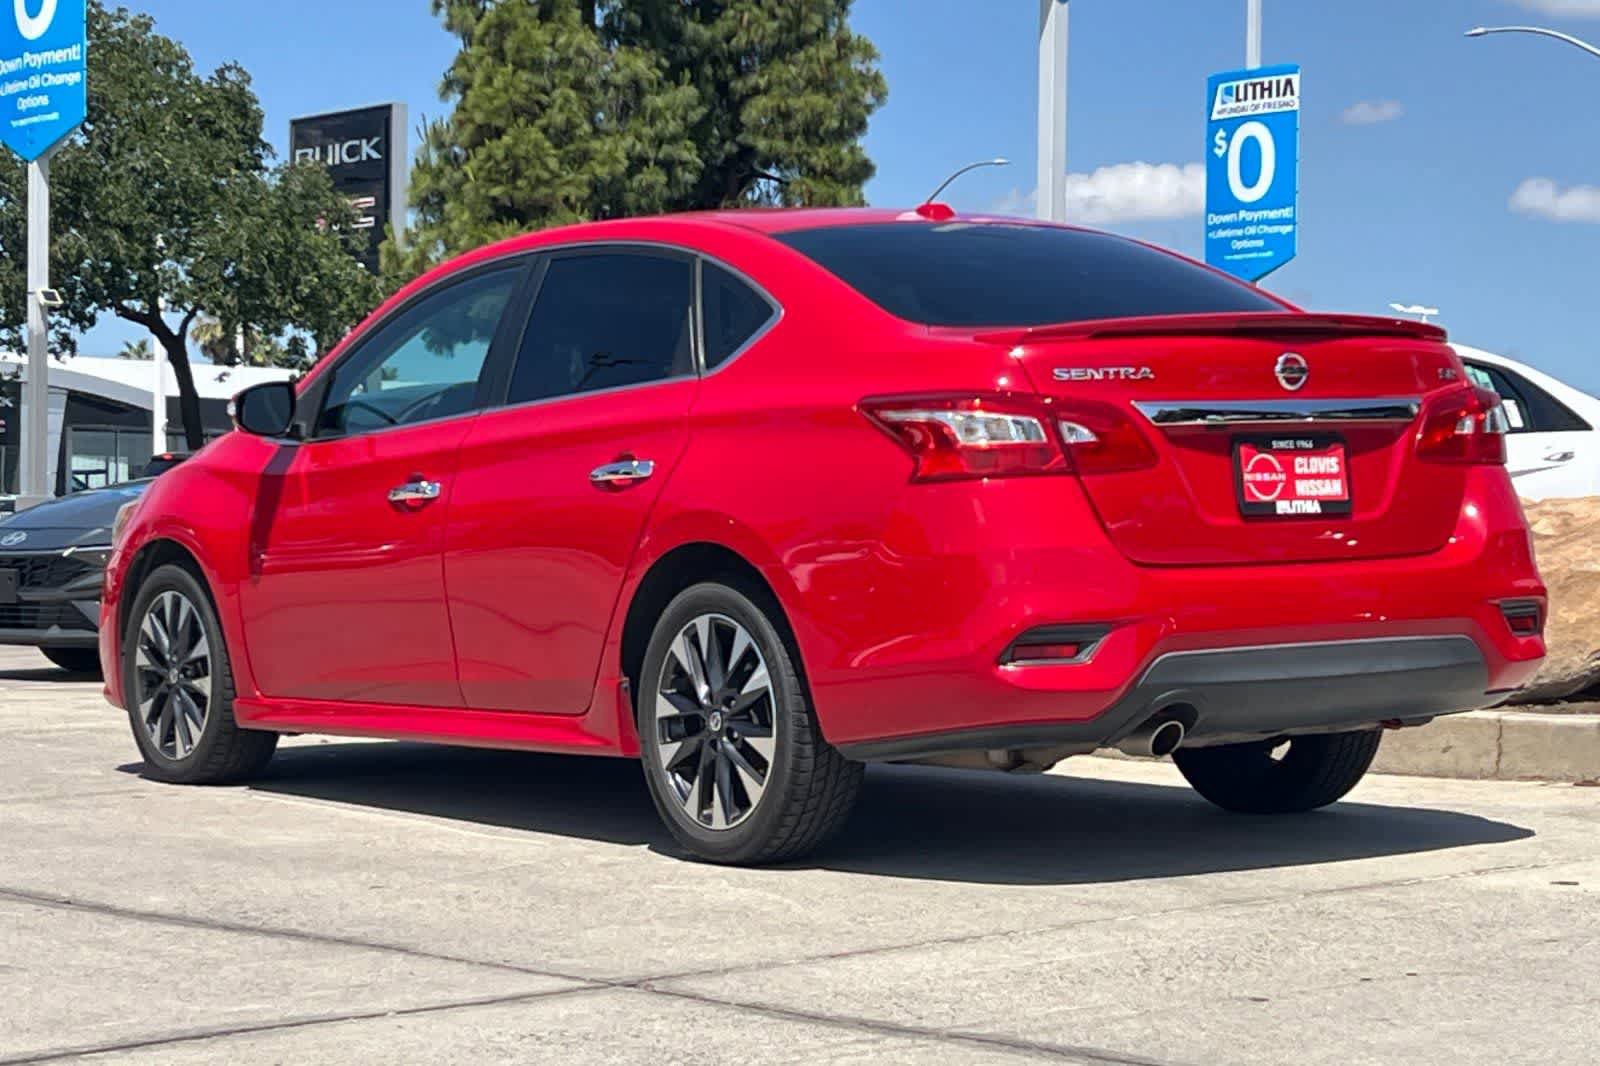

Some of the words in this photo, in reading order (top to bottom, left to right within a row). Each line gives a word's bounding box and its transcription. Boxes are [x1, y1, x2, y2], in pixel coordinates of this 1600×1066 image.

[23, 43, 81, 69] Payment!
[28, 73, 40, 89] Oil
[41, 71, 81, 87] Change
[1235, 78, 1295, 103] LITHIA
[17, 94, 49, 112] Options
[1207, 212, 1238, 226] Down
[1257, 224, 1294, 235] Change
[1231, 239, 1264, 250] Options
[1053, 366, 1155, 381] SENTRA
[1271, 439, 1295, 449] SINCE
[1294, 456, 1340, 475] CLOVIS
[1243, 472, 1286, 482] NISSAN
[1294, 479, 1343, 497] NISSAN
